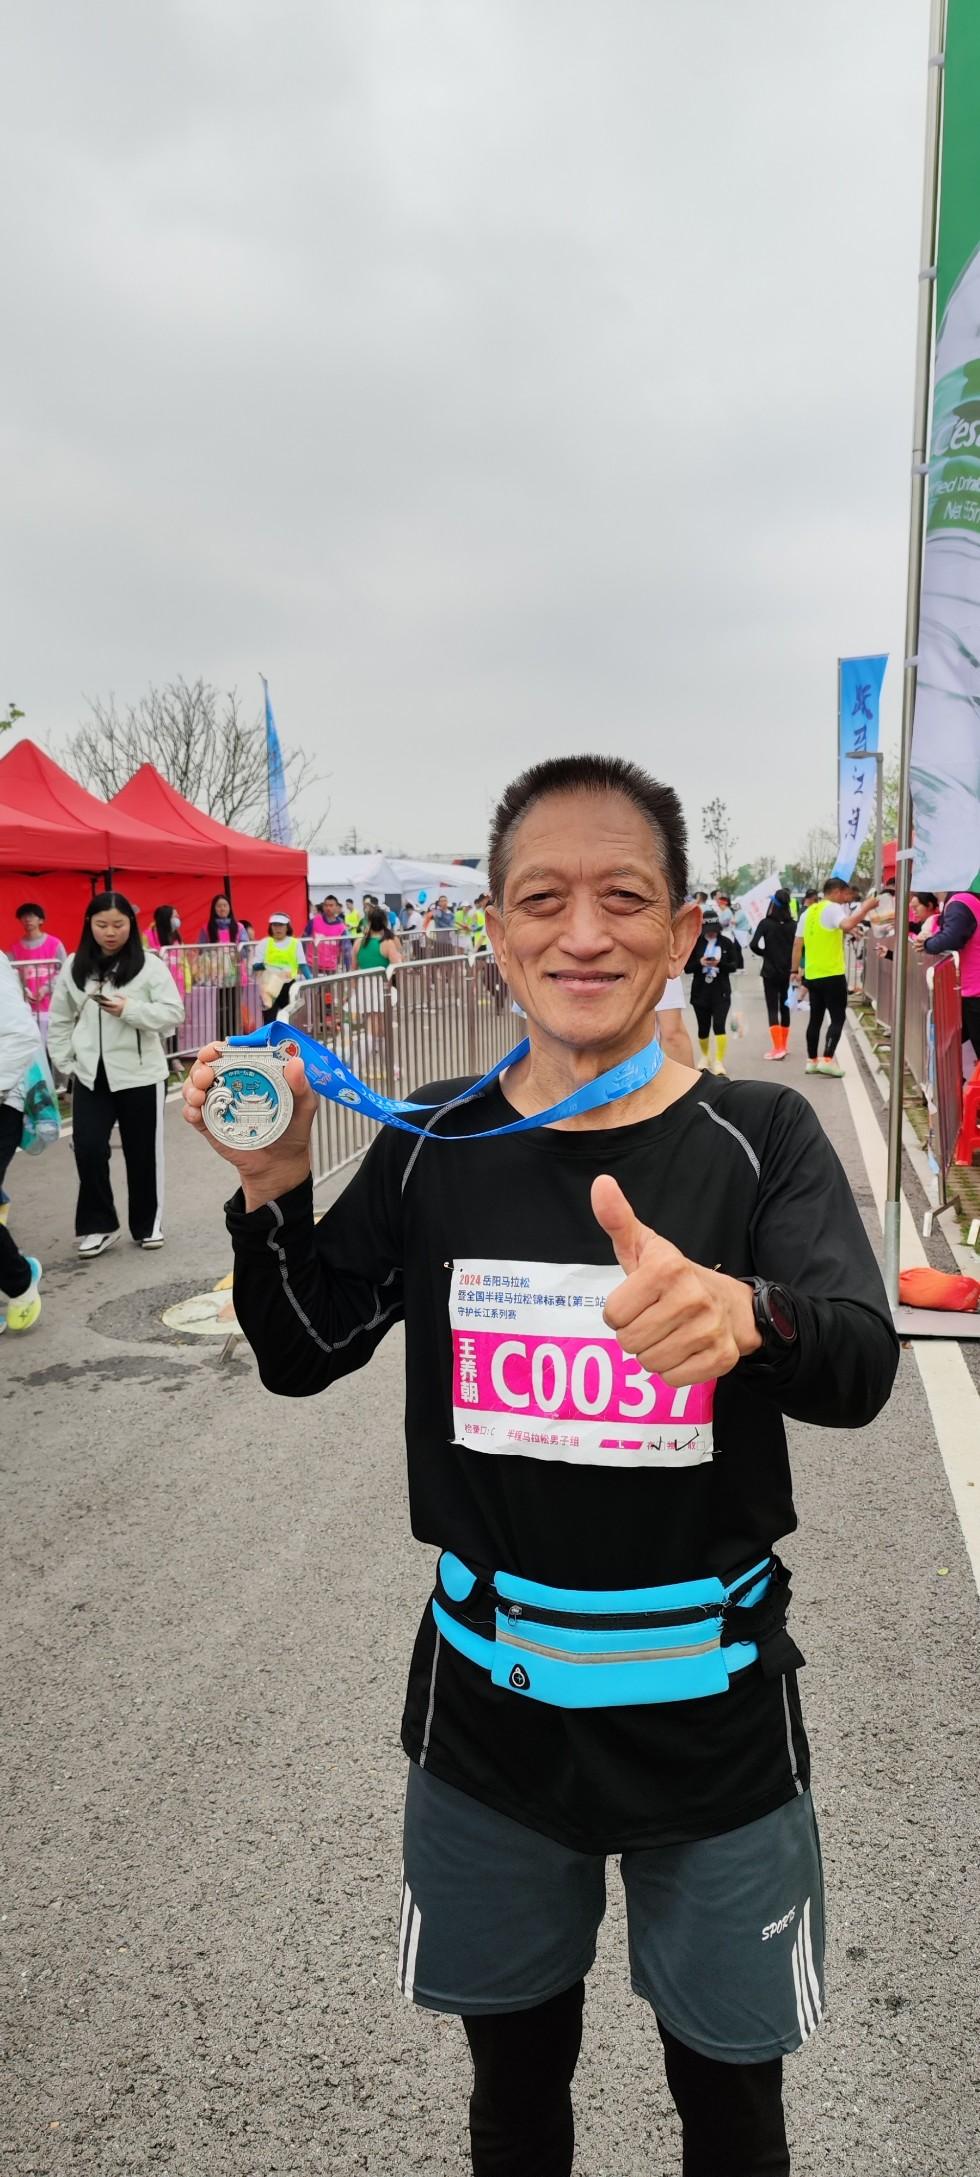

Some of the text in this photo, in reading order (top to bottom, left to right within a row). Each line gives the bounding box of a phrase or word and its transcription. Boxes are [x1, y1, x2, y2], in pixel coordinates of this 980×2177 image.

[459, 1274, 530, 1288] 2024 岳阳马拉松
[457, 1306, 517, 1321] 守护长江系列赛
[458, 1337, 480, 1404] 王养朝
